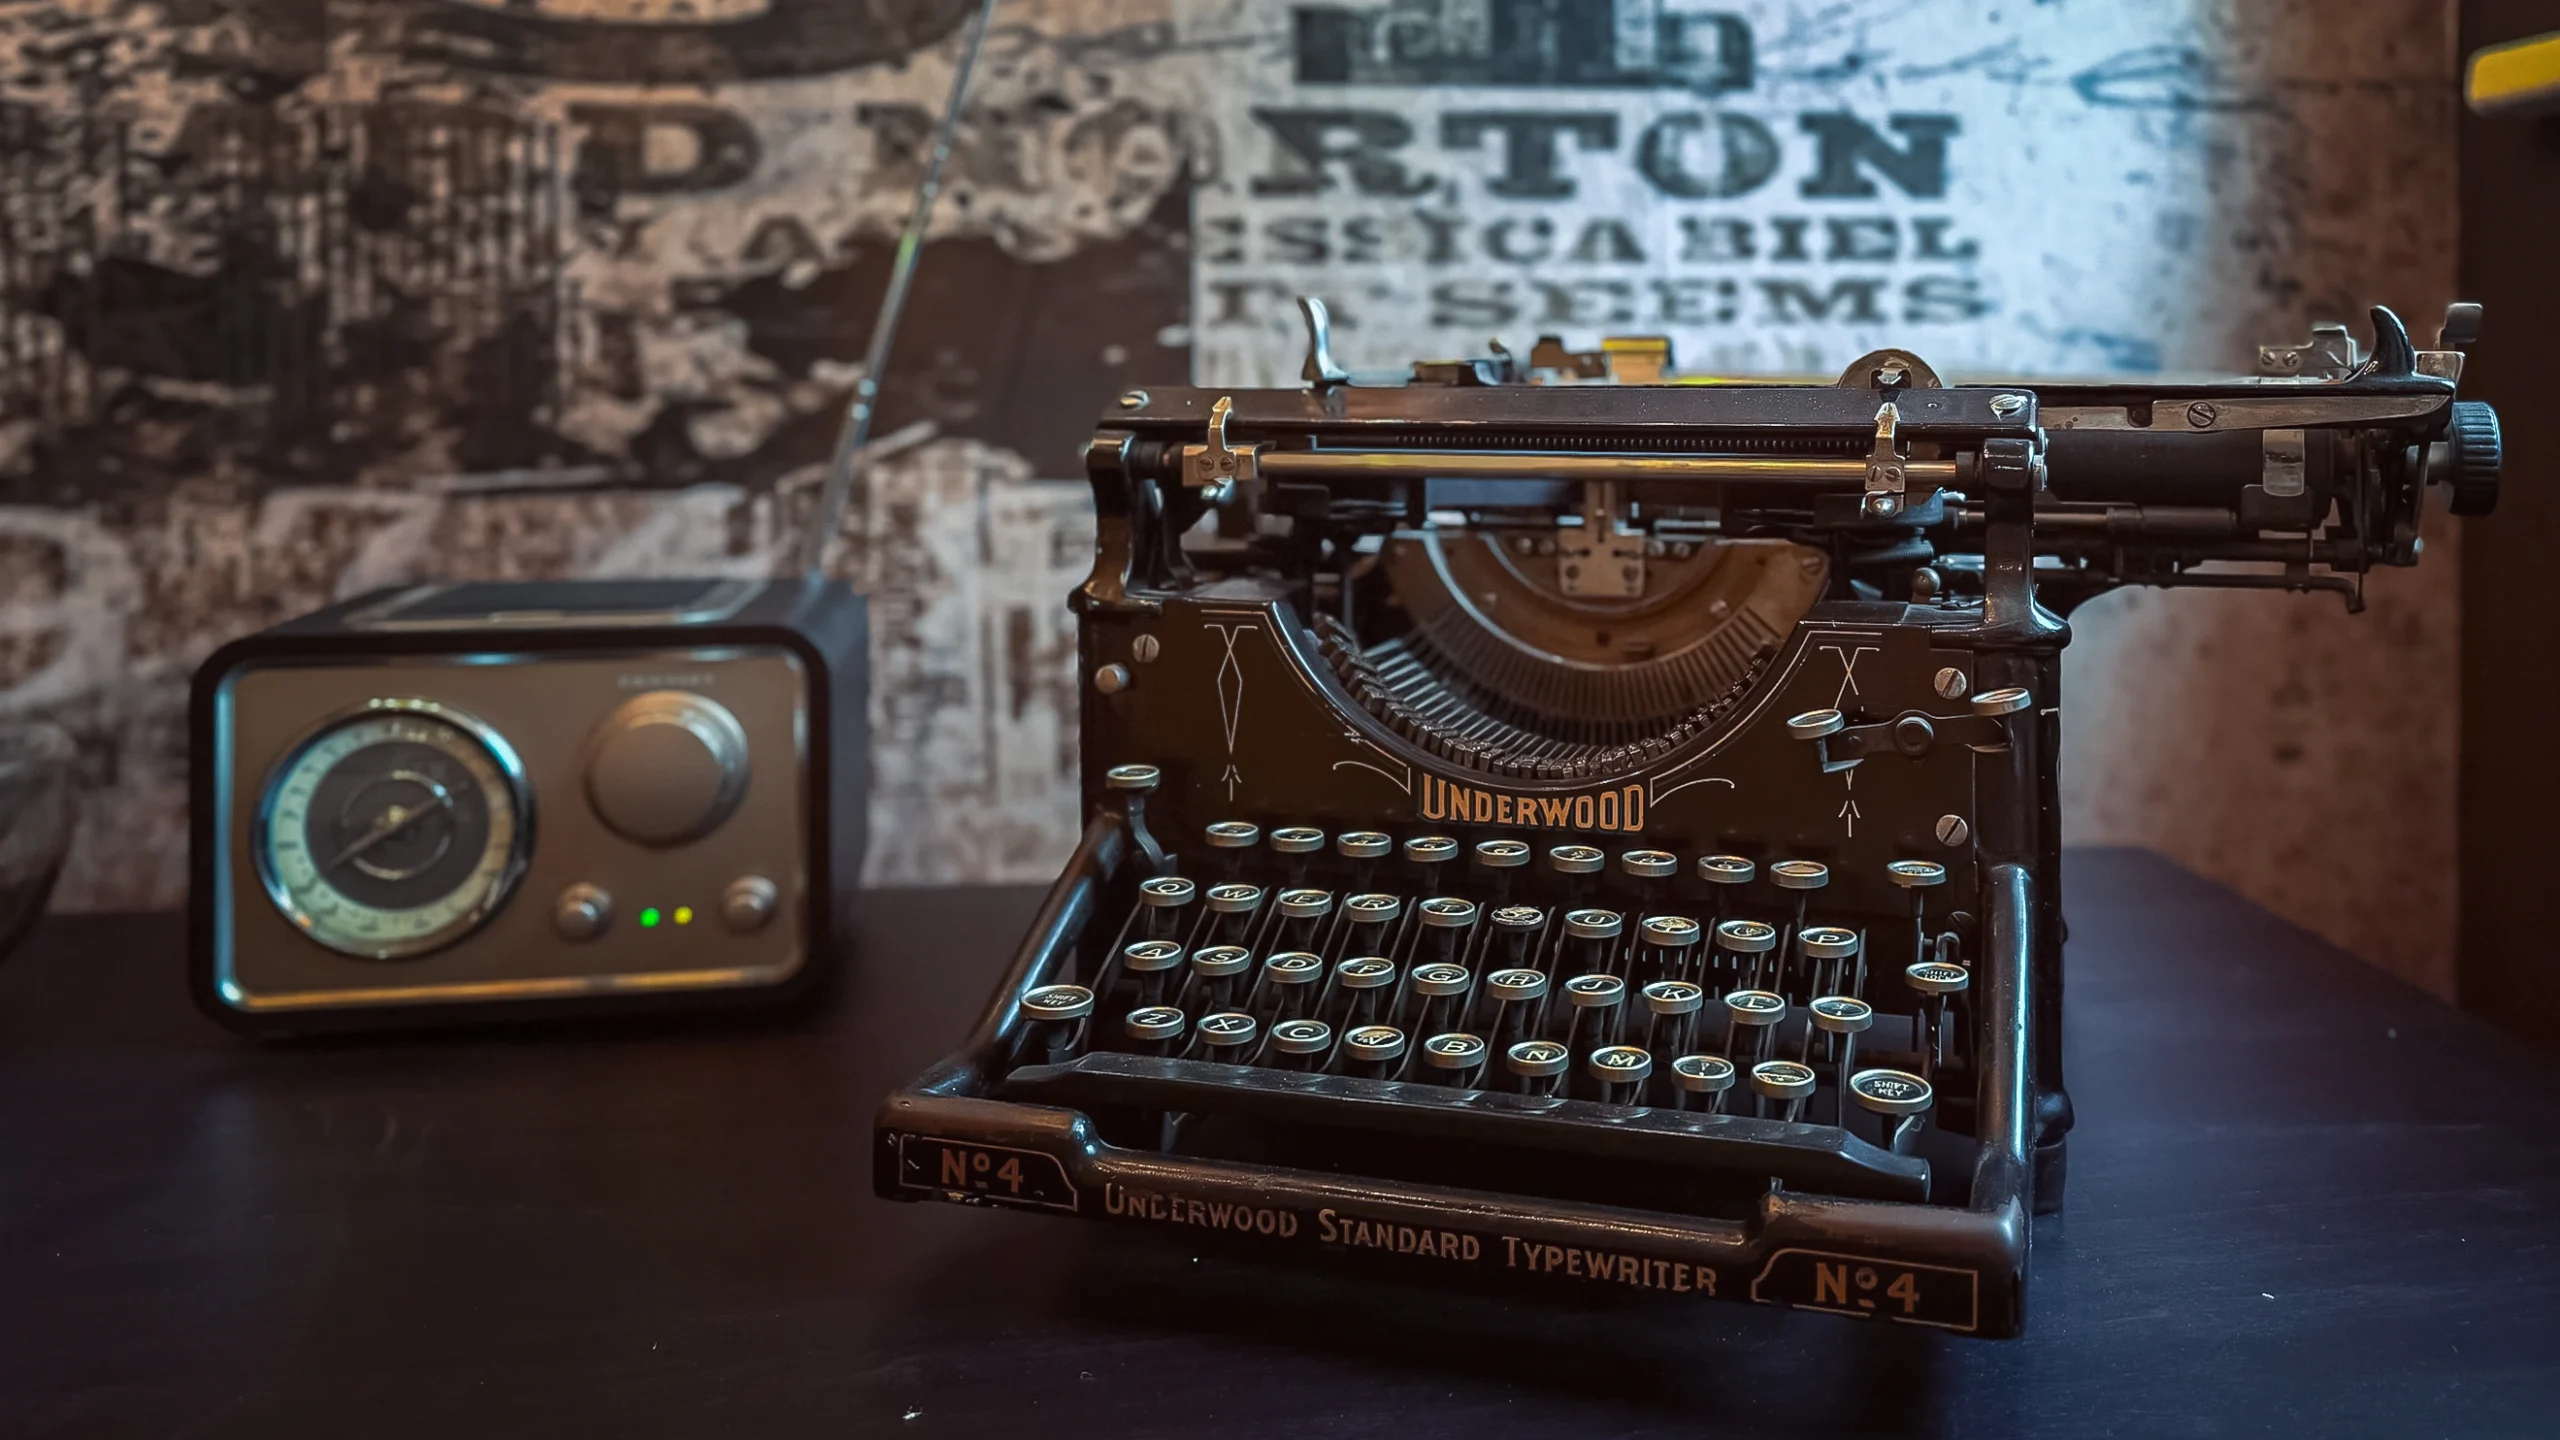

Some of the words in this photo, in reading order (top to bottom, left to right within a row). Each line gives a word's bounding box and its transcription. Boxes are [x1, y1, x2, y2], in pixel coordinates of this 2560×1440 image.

[1680, 217, 1981, 263] BIEL
[1431, 280, 1992, 330] SEEMS
[1423, 773, 1644, 832] UNDERWOOD
[1210, 1018, 1239, 1031] X
[1289, 1027, 1315, 1038] C
[1441, 1040, 1468, 1053] B
[1525, 1050, 1550, 1061] N
[1607, 1054, 1636, 1067] M
[1105, 1182, 1298, 1238] UNDERWOOD
[1319, 1208, 1481, 1261] STANDARD
[1501, 1235, 1718, 1297] TYPEWRITER
